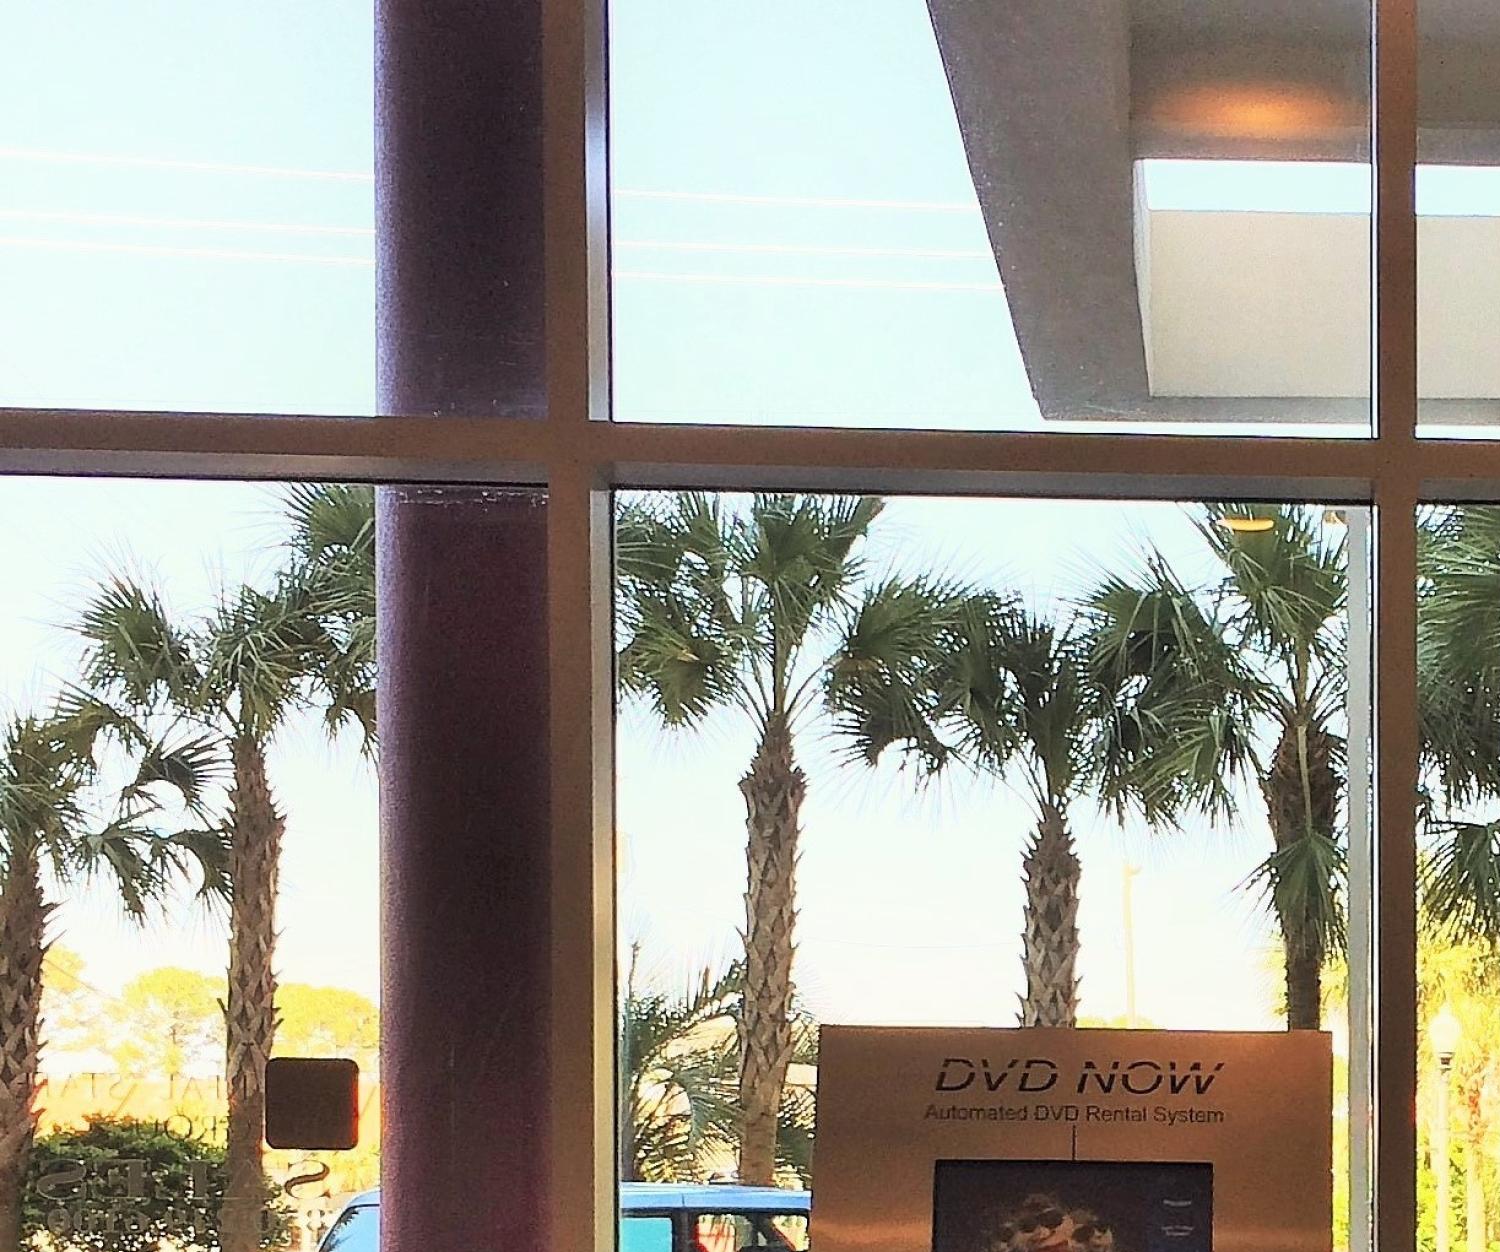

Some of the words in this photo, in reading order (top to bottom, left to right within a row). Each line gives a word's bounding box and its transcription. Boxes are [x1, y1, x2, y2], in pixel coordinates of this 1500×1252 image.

[935, 1058, 1058, 1092] DVD
[1076, 1060, 1224, 1095] NOW
[925, 1103, 1028, 1122] Automated
[1034, 1105, 1079, 1122] DVD
[1087, 1105, 1147, 1123] Rental
[1153, 1105, 1224, 1126] System
